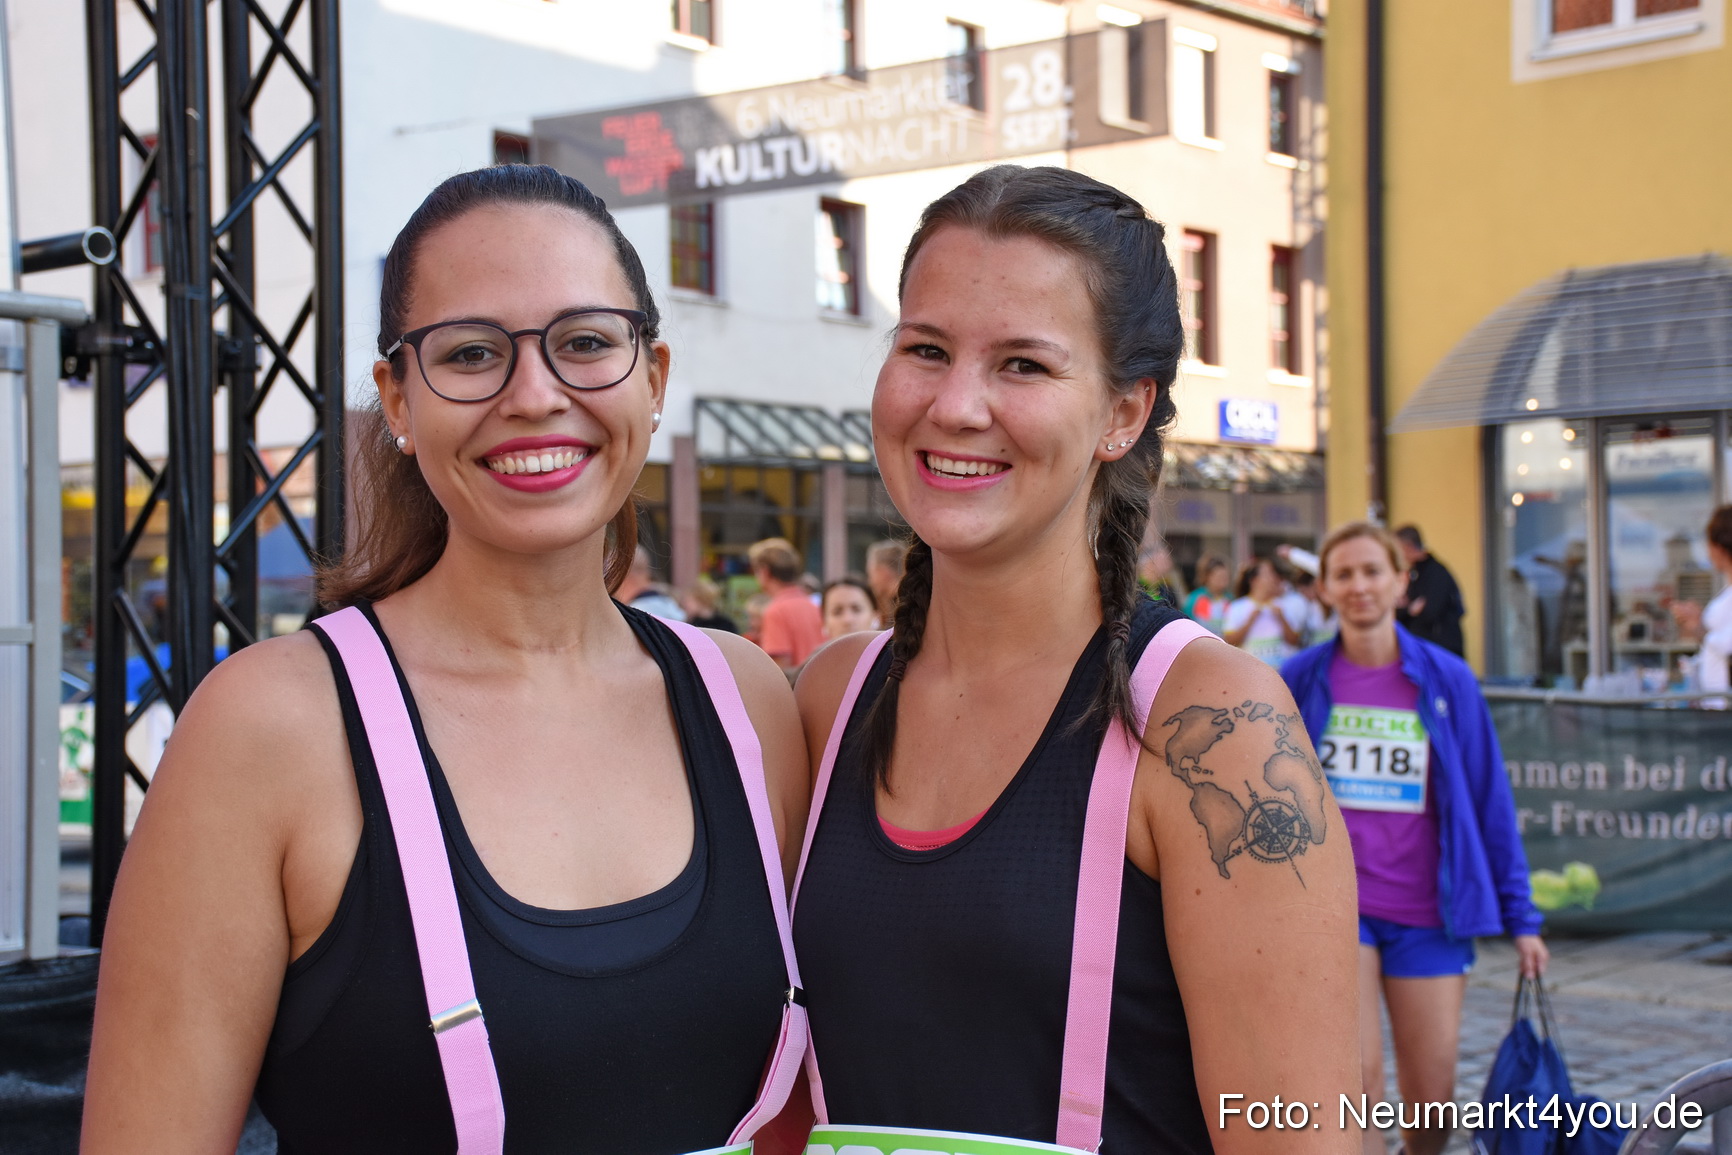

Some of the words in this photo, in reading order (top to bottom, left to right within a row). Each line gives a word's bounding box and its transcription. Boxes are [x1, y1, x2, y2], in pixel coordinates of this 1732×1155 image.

[694, 117, 970, 188] KULTURNACHT
[1623, 754, 1687, 792] bei
[1700, 755, 1732, 792] d
